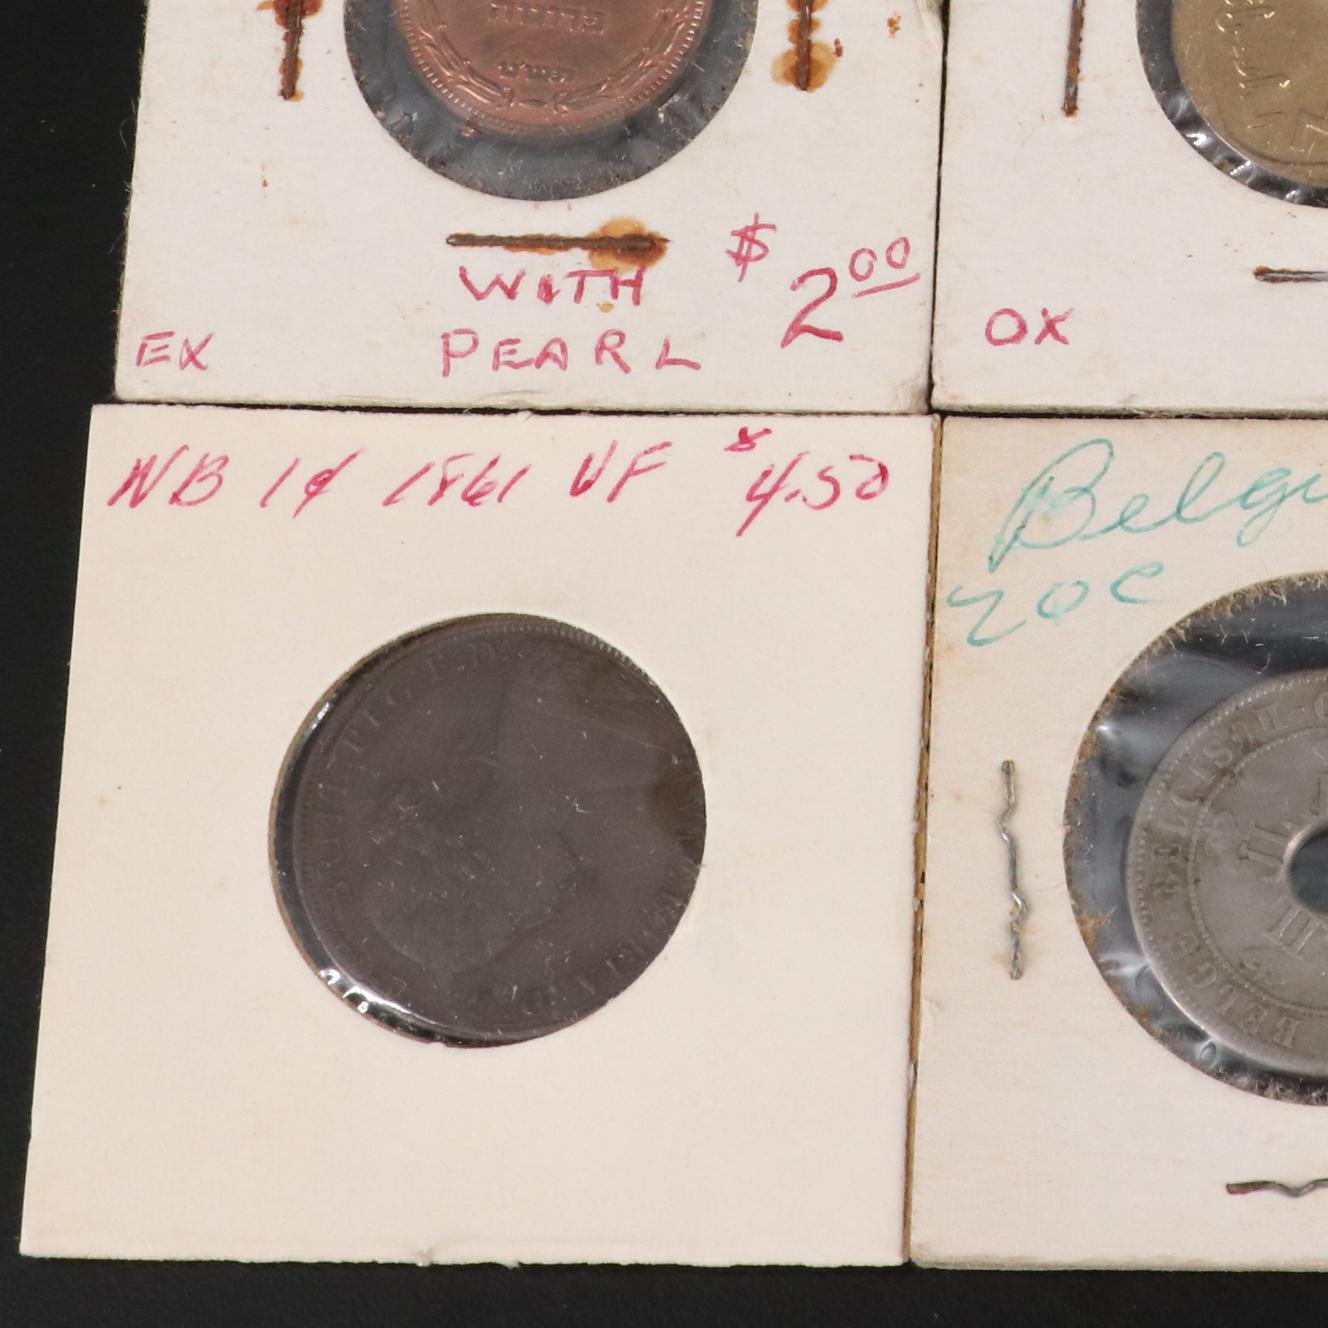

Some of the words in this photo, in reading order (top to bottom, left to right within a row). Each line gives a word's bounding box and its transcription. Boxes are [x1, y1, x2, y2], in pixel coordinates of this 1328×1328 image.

[459, 266, 647, 307] WITH
[135, 332, 214, 372] EX
[440, 329, 701, 376] PEARL
